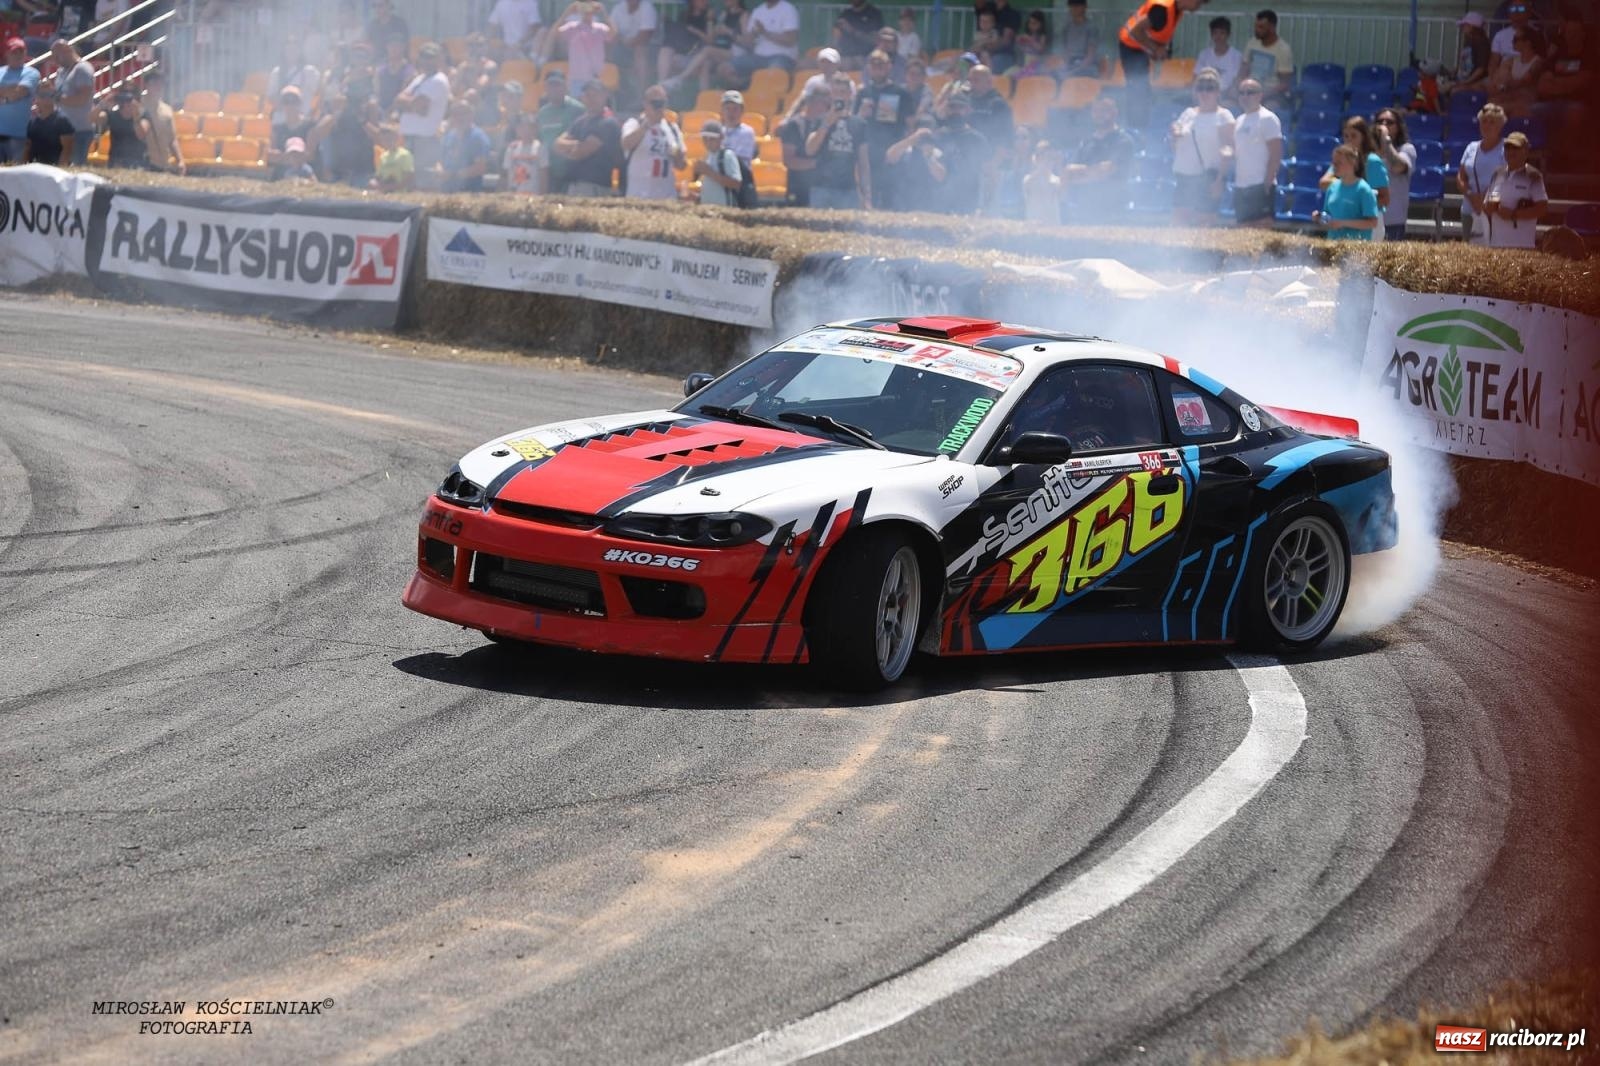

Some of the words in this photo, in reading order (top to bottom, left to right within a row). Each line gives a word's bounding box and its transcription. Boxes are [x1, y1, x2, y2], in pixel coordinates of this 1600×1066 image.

[111, 210, 357, 285] RALLYSHOP
[936, 397, 994, 452] TRACKWOOD
[1142, 454, 1162, 470] 366
[942, 475, 964, 500] SHOP
[603, 548, 700, 571] #KO366
[1006, 466, 1185, 613] 366
